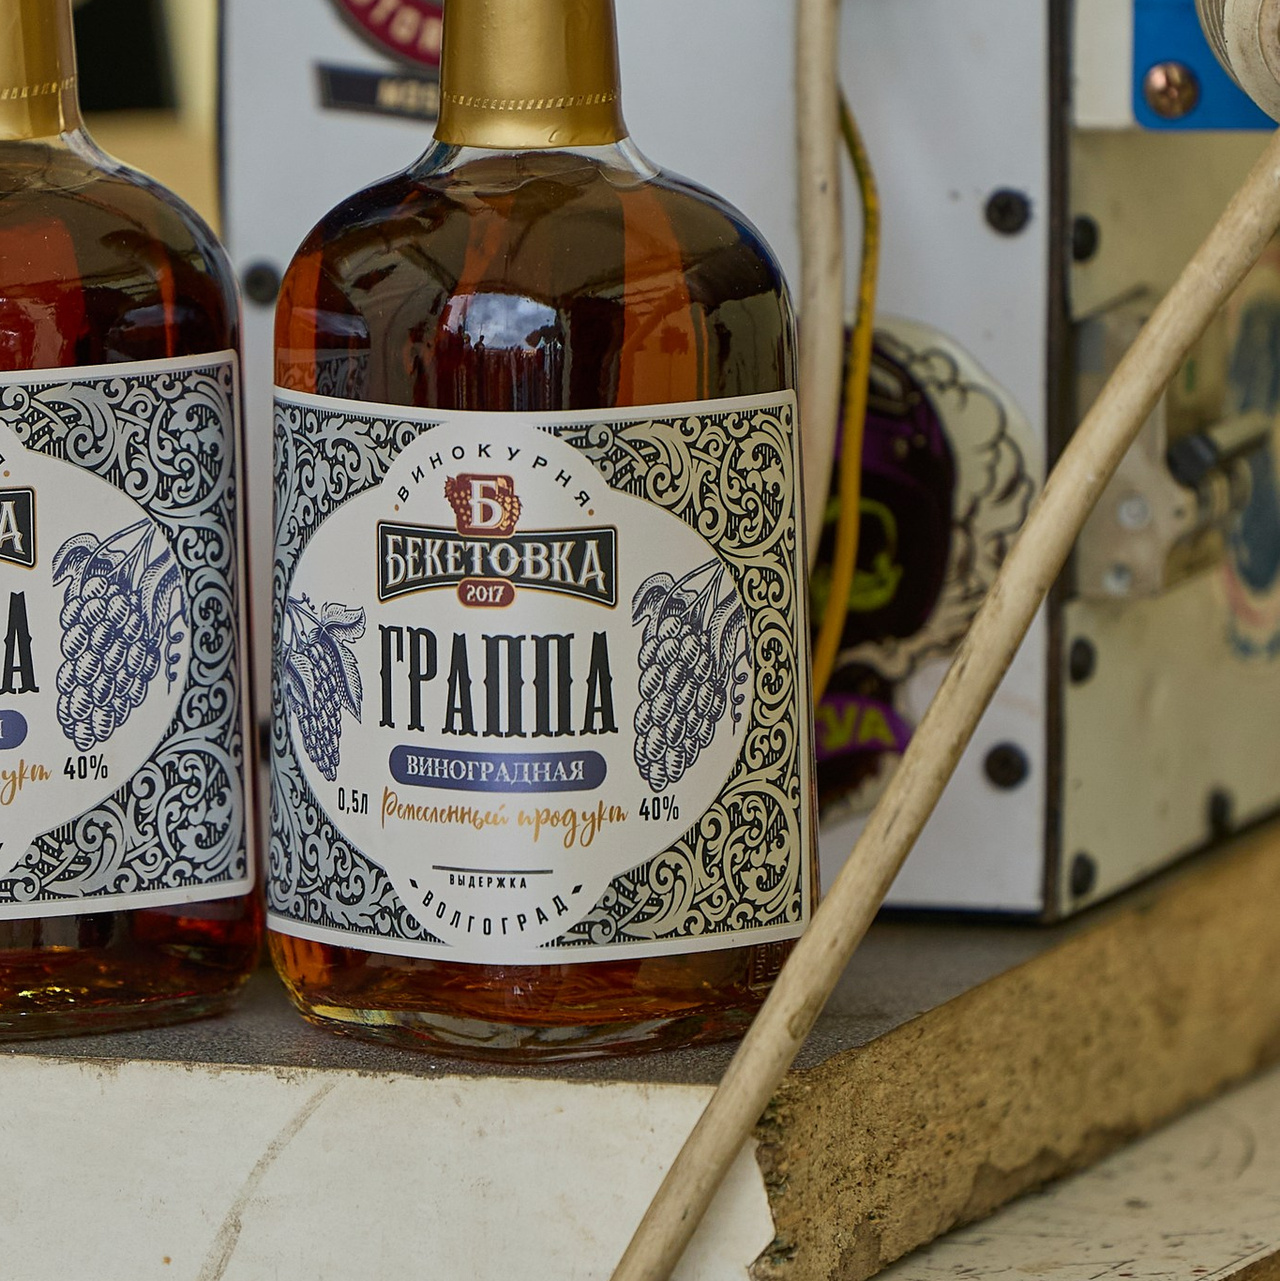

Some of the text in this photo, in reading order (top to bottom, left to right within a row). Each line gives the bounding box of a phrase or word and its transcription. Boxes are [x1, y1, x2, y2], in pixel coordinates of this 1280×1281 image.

[397, 443, 590, 507] ВИНОКУРНЯ
[468, 479, 504, 529] Б
[385, 534, 608, 594] БЕКЕТОВКА
[466, 584, 505, 603] 2017
[378, 624, 618, 739] ГРАППА
[63, 753, 108, 780] 40%
[405, 754, 586, 783] ВИНОГРАДНАЯ
[381, 786, 629, 848] Ремесленный продукт
[639, 795, 679, 821] 40%
[449, 873, 527, 889] ВЫДЕРЖКА
[422, 894, 569, 936] ВОЛГОГРАД
